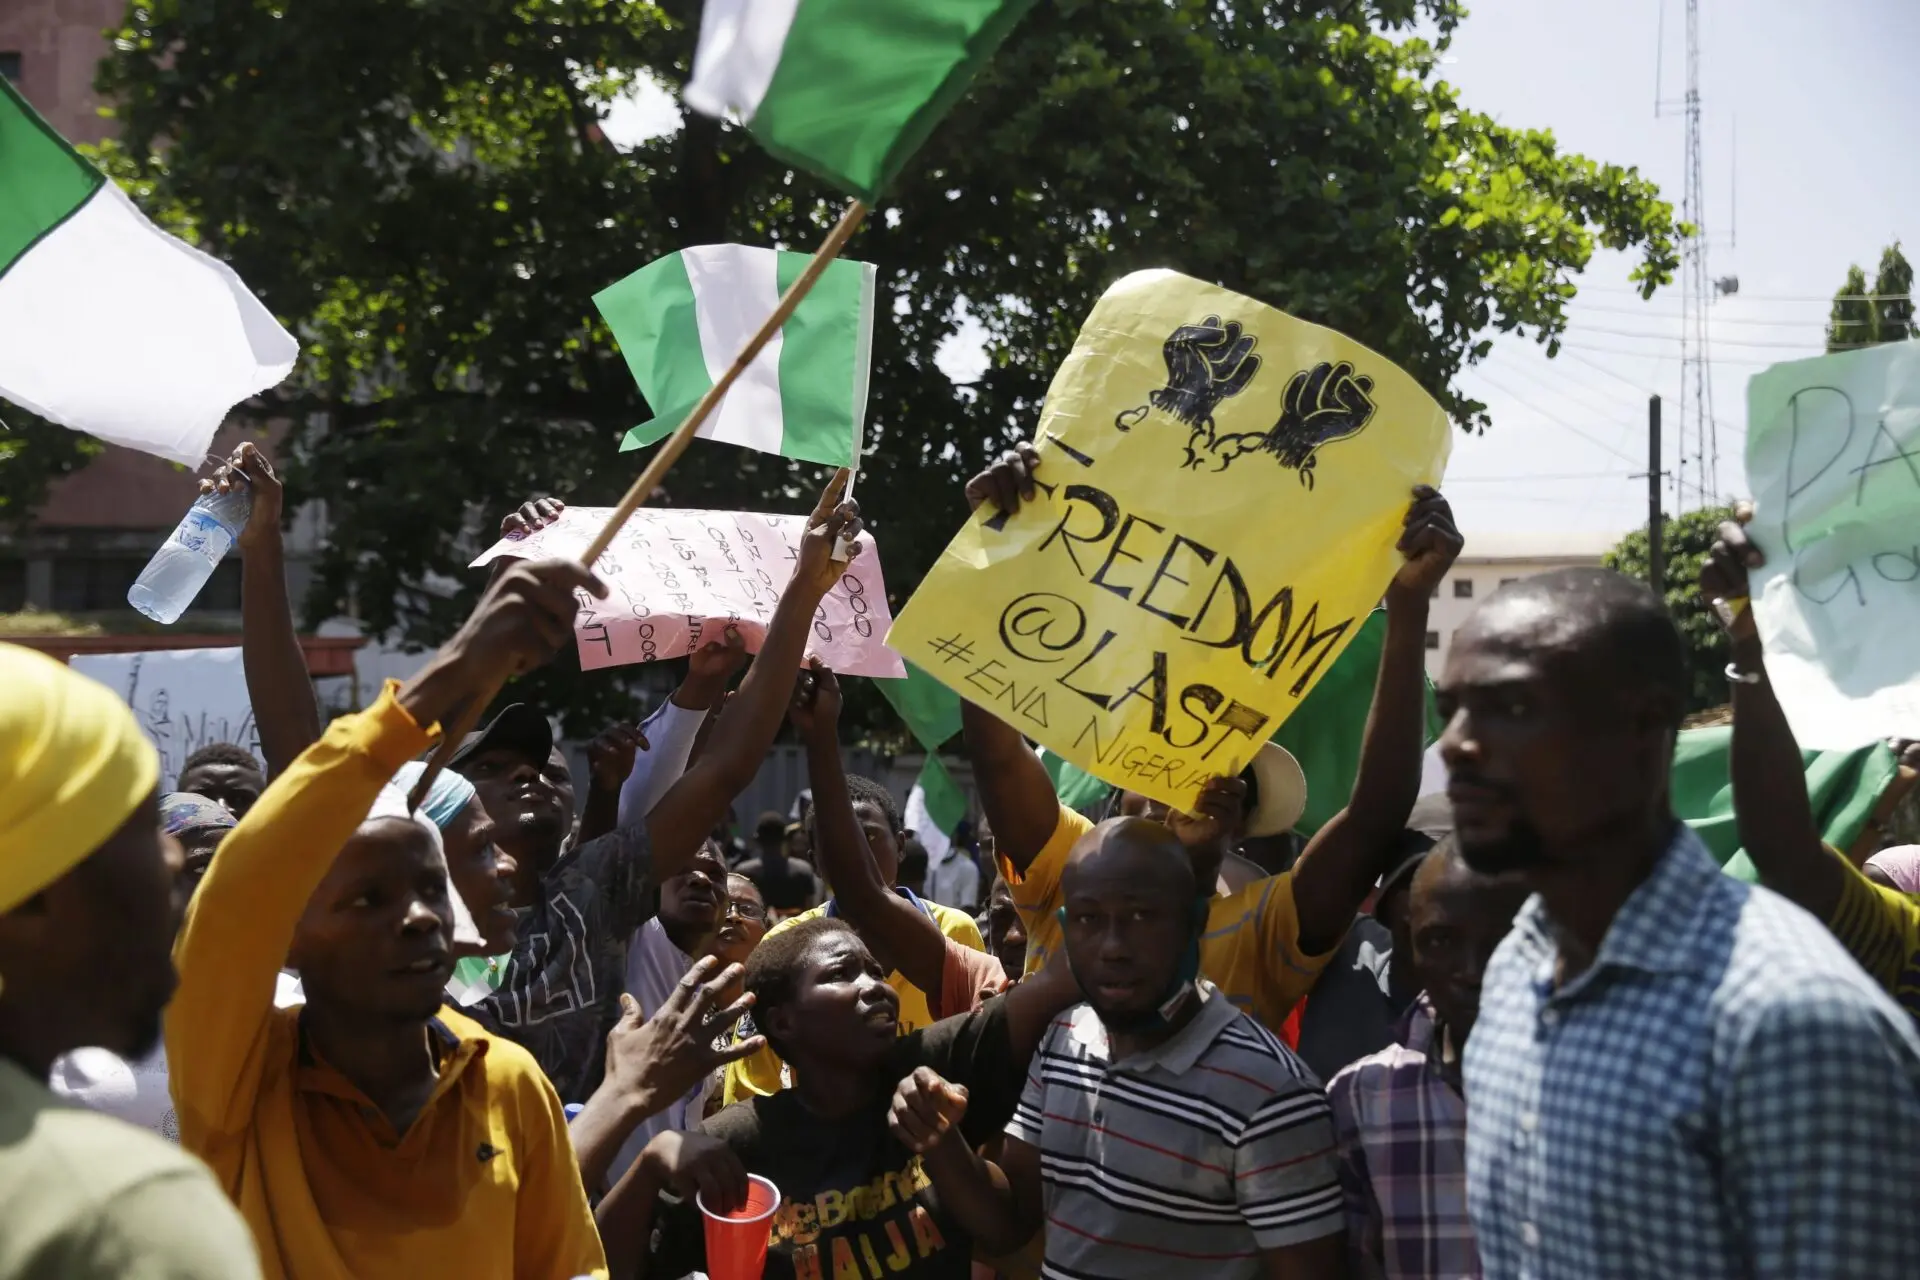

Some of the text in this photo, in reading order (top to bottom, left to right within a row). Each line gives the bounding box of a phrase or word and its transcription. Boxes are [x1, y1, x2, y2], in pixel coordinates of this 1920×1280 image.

[577, 590, 612, 657] ENT
[999, 592, 1270, 760] @LAST
[927, 632, 1211, 790] #END NIGERIA
